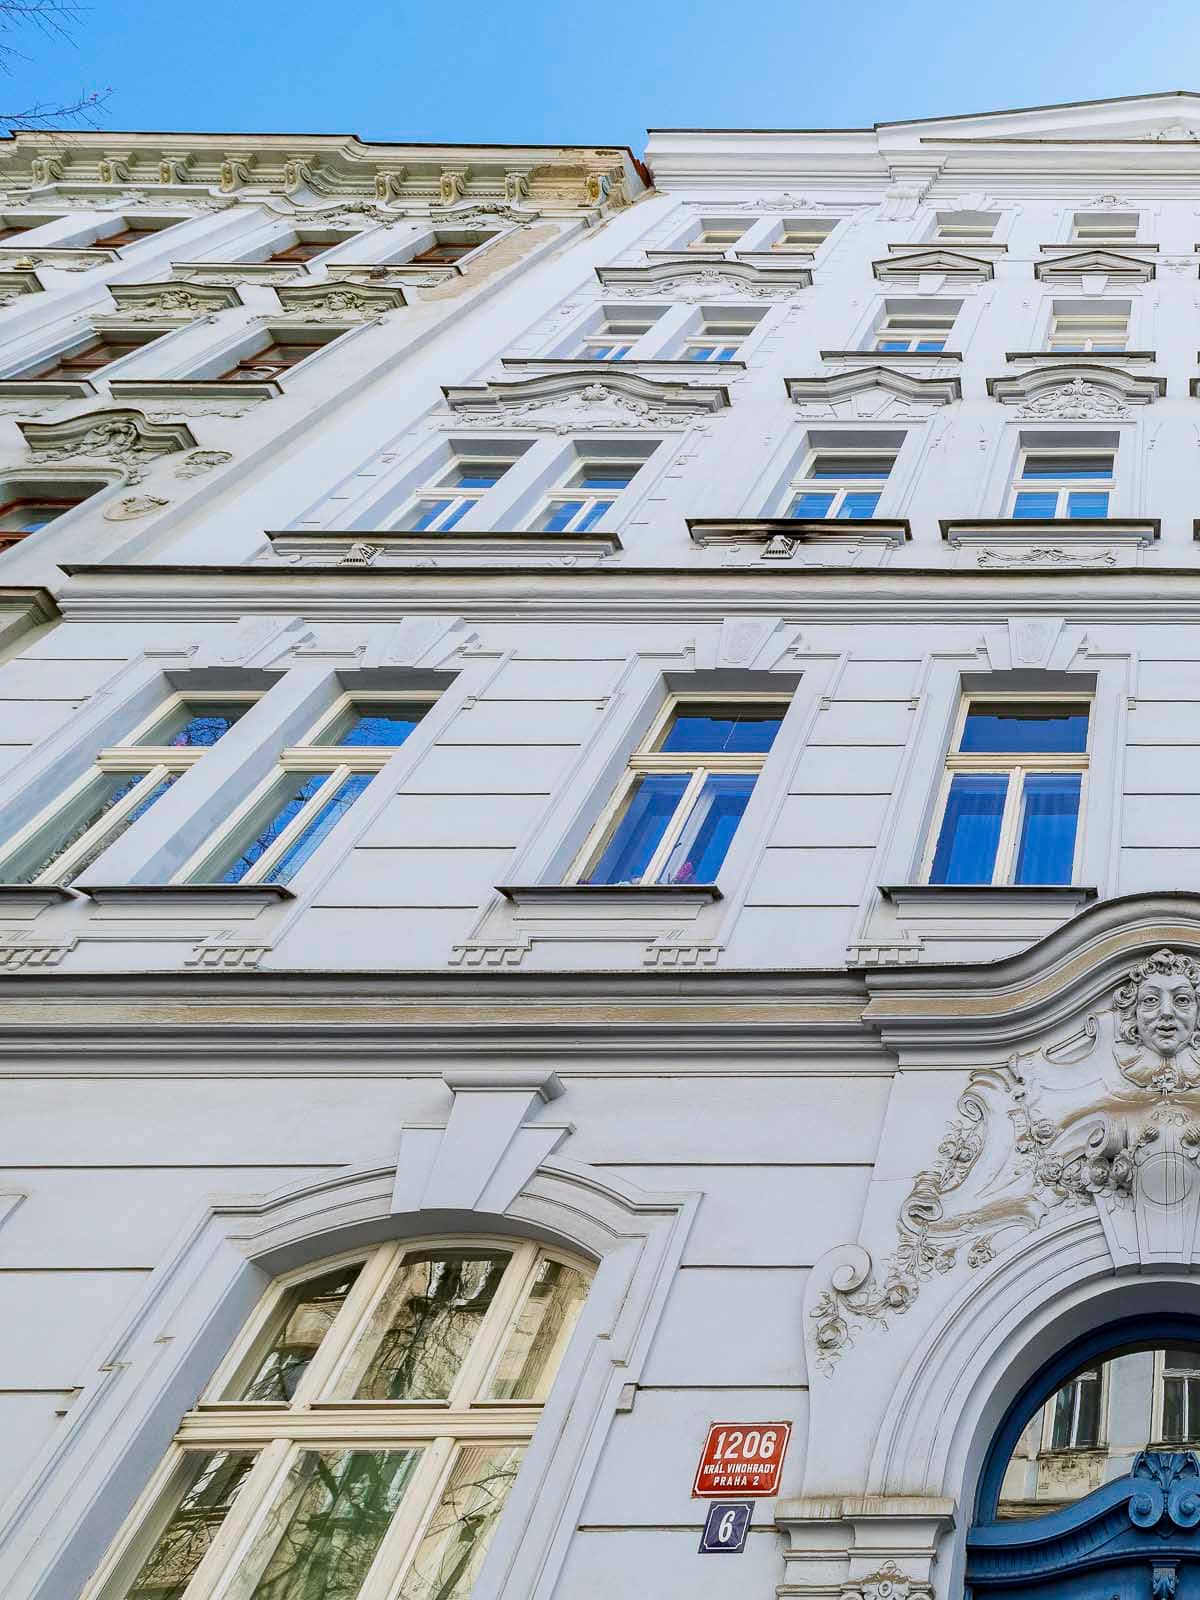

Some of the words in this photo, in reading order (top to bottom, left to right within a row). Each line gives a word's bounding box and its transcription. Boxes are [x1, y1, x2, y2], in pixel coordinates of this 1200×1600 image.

[713, 1431, 777, 1460] 1206
[727, 1463, 776, 1474] VINOHRADY
[713, 1476, 747, 1486] PRAHA
[752, 1475, 760, 1486] 2
[718, 1510, 736, 1543] 6
